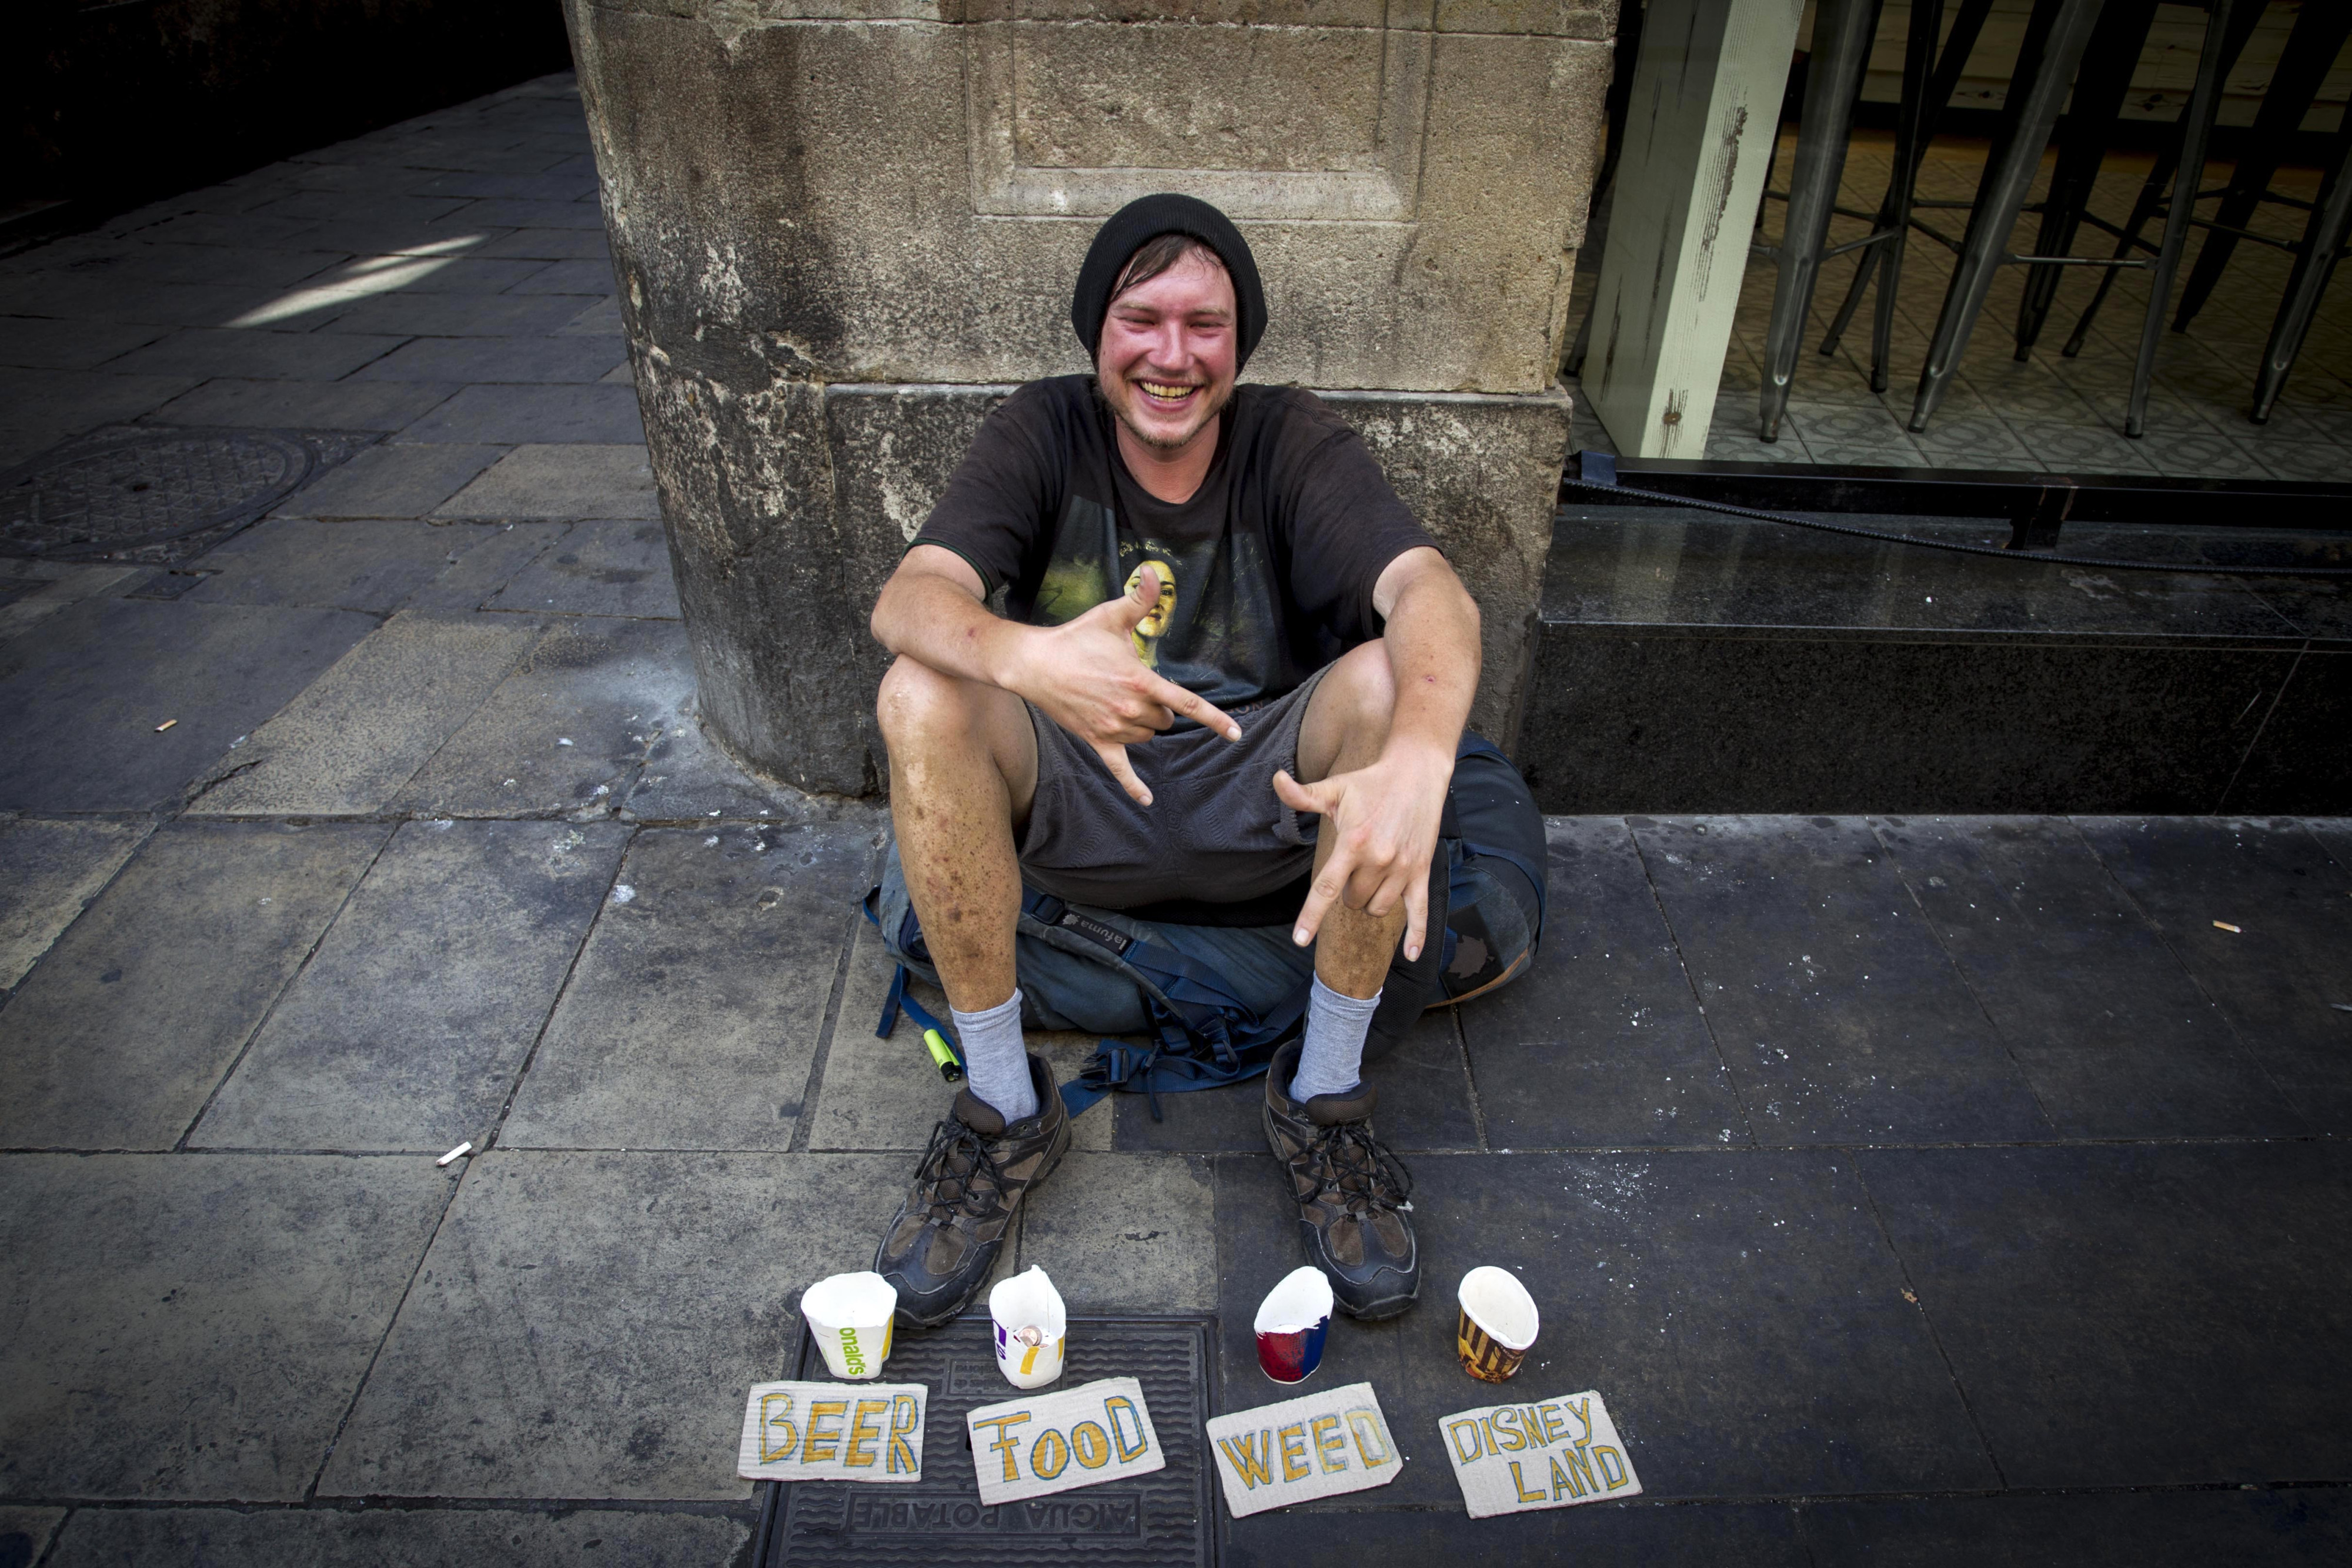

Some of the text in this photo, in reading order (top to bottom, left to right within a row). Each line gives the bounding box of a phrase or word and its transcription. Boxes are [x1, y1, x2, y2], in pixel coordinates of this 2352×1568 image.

[1081, 920, 1127, 950] lafuma
[759, 1392, 918, 1475] BEER
[973, 1396, 1148, 1483] FOOD
[1217, 1407, 1394, 1490] WEED
[1446, 1396, 1591, 1465] DISNEY
[1509, 1445, 1630, 1503] LAND
[853, 1501, 1132, 1529] AIGUA POTABLE
